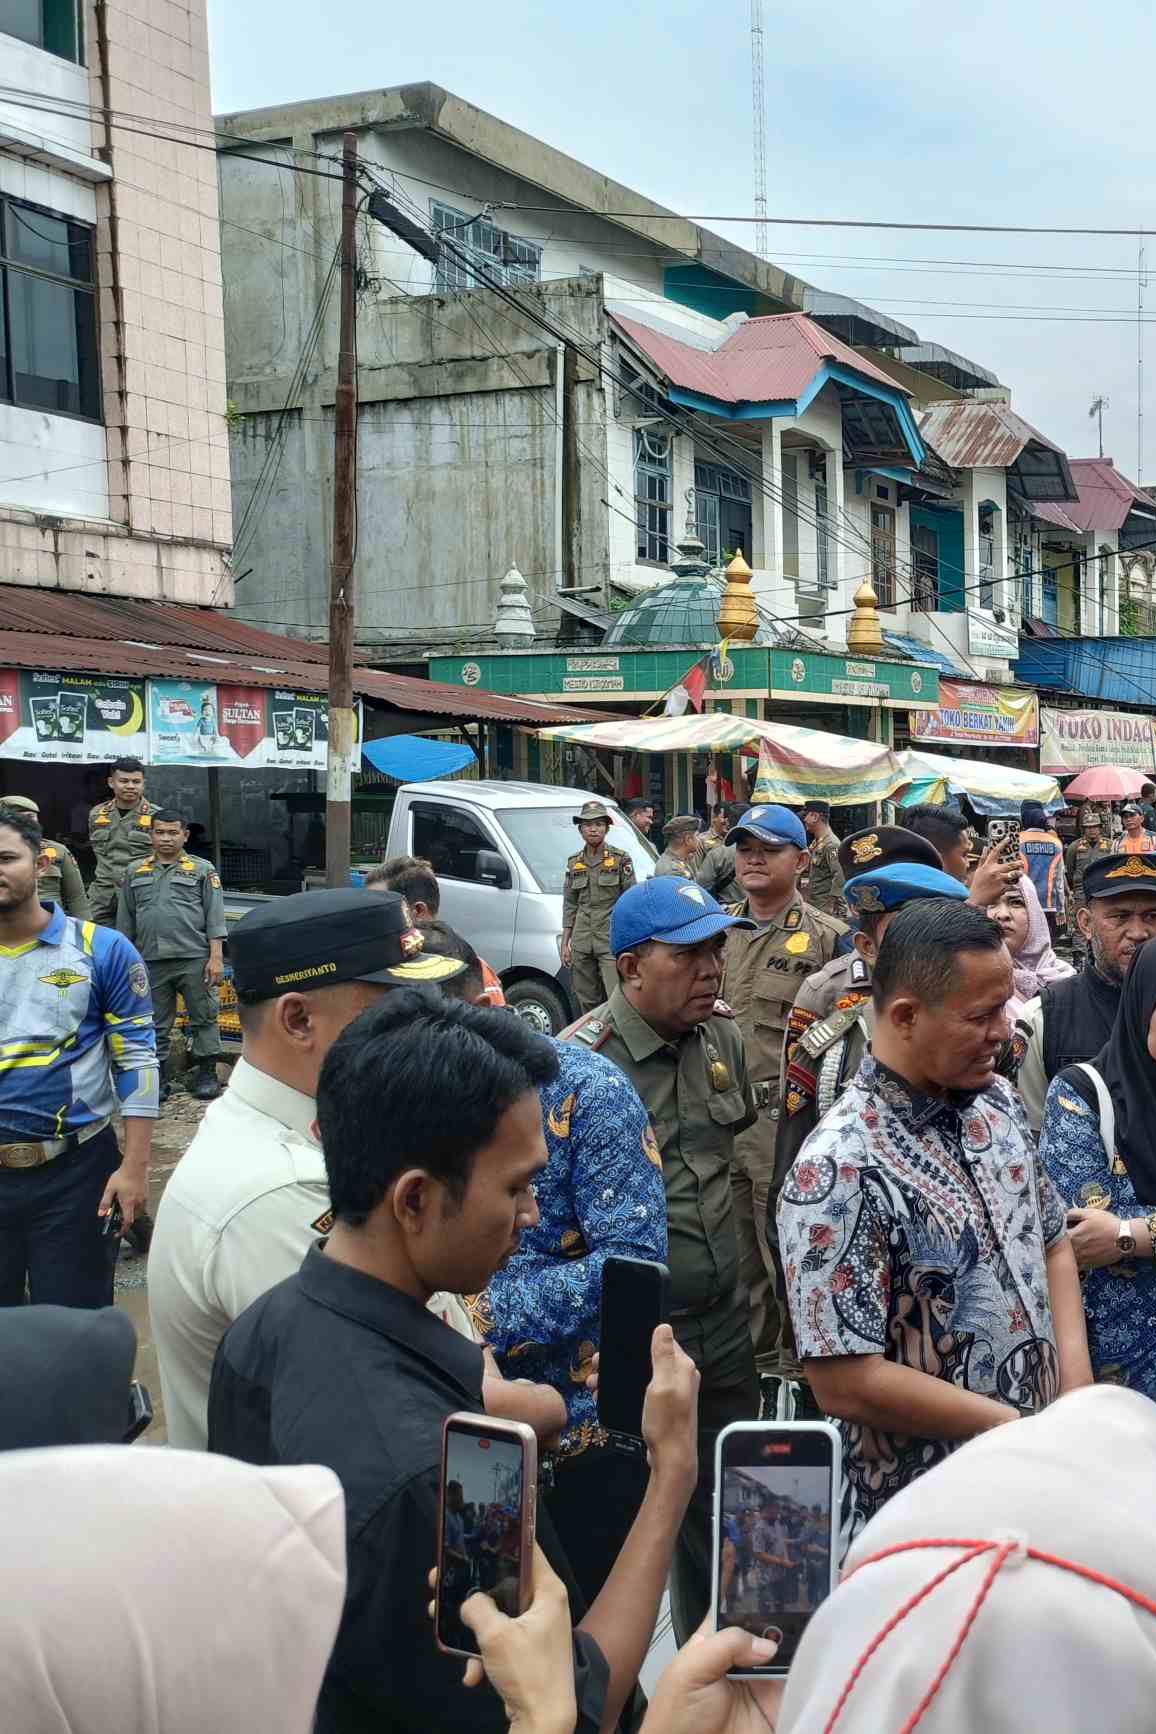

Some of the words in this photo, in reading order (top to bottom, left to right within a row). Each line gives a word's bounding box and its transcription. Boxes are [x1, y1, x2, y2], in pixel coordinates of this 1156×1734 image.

[223, 708, 261, 720] SULTAN
[940, 709, 961, 728] TOKO
[962, 711, 993, 729] BERKAT
[1058, 715, 1102, 739] TOKO
